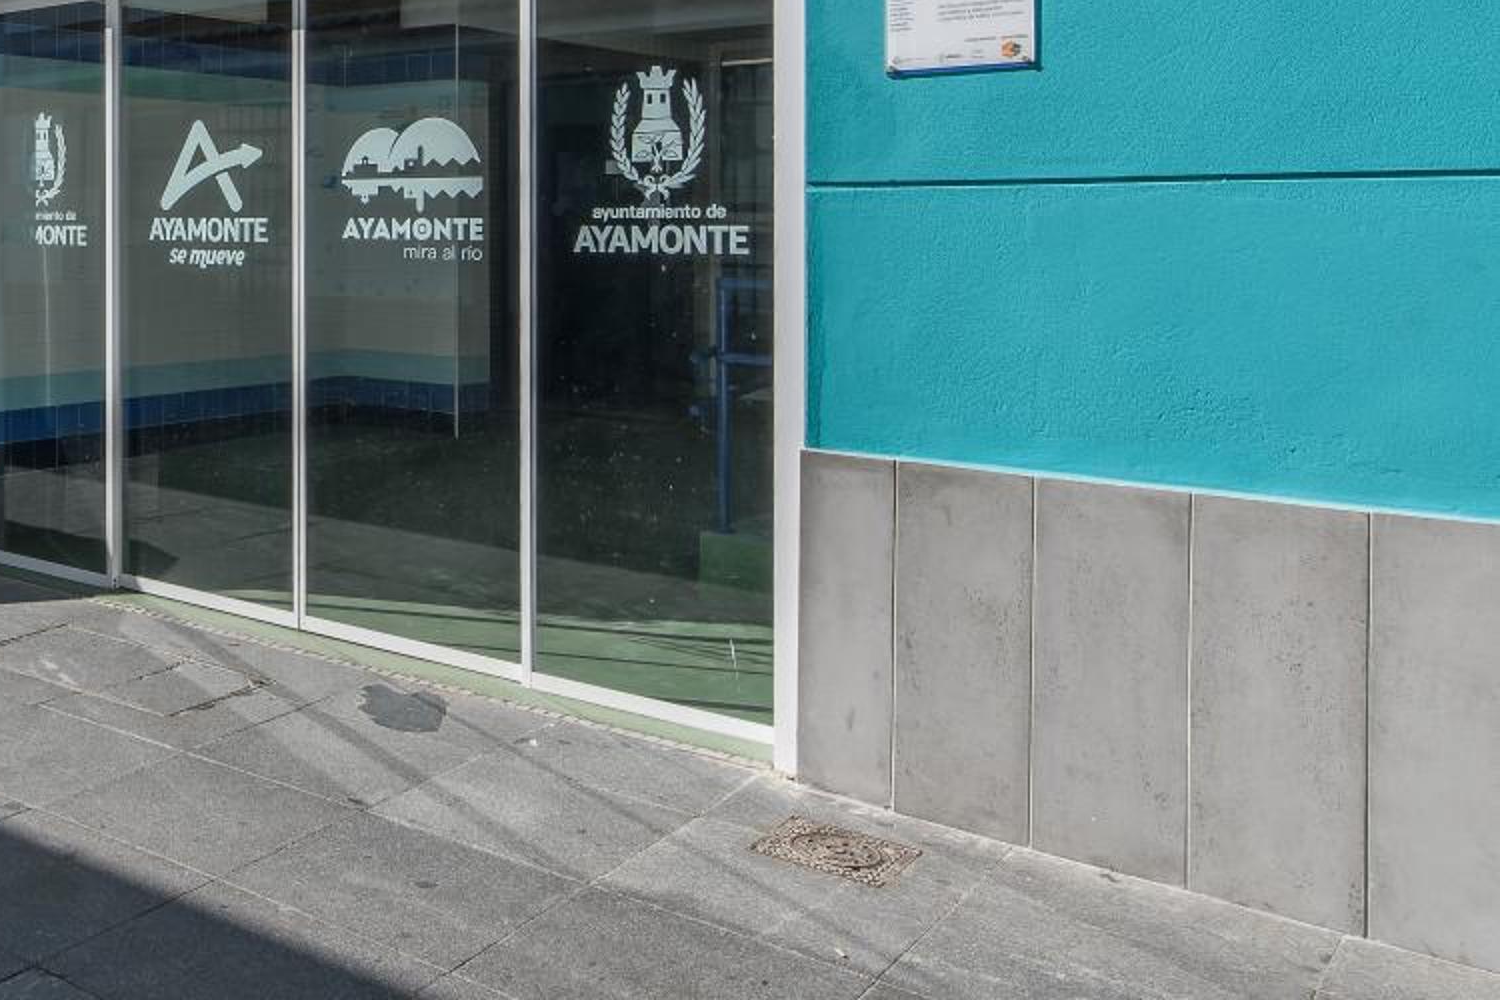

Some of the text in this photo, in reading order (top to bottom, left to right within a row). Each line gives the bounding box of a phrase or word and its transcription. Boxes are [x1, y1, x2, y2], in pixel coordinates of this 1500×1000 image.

[592, 203, 727, 223] ayuntamiento de
[149, 217, 269, 243] AYAMONTE
[341, 217, 485, 241] AYAMONTE
[573, 224, 750, 255] AYAMONTE
[169, 247, 245, 269] se mueve
[403, 244, 483, 261] mira al río
